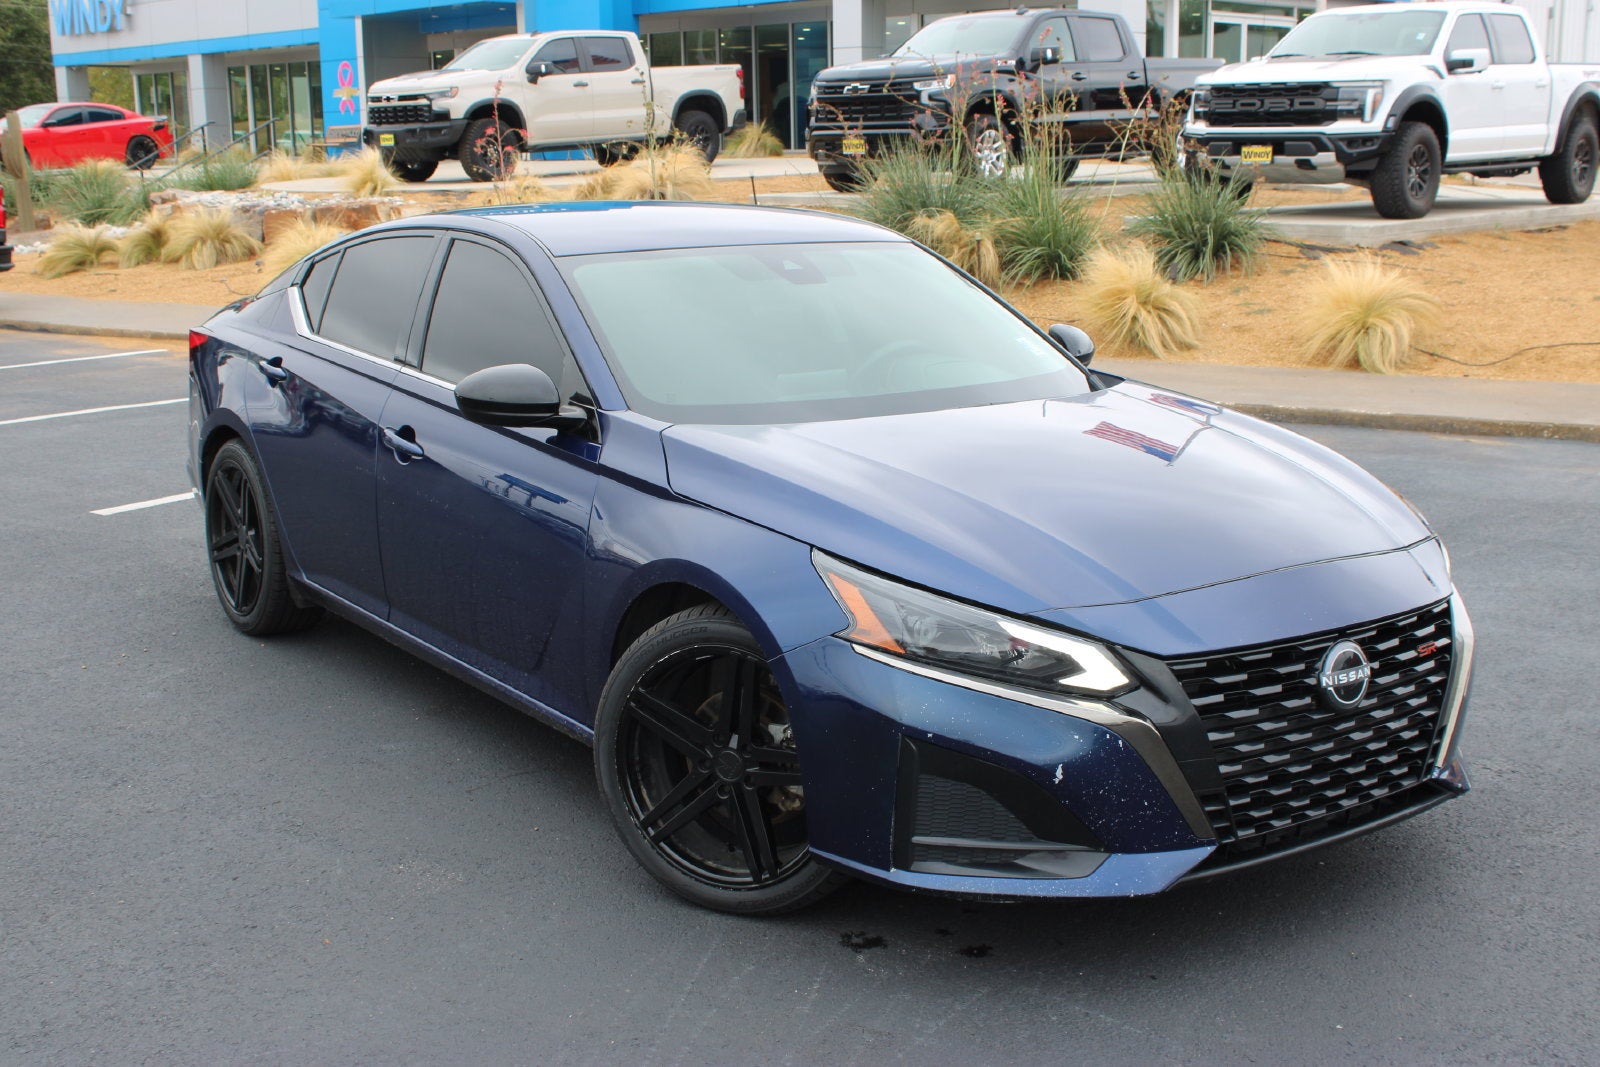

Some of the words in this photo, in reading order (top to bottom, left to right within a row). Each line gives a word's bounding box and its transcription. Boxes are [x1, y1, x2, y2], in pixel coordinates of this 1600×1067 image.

[50, 0, 122, 36] WINDY
[1209, 97, 1326, 112] FORD
[1243, 150, 1271, 160] WINDY
[656, 626, 708, 646] HUGGER
[1417, 641, 1437, 657] SR
[1322, 666, 1371, 687] NISSAN
